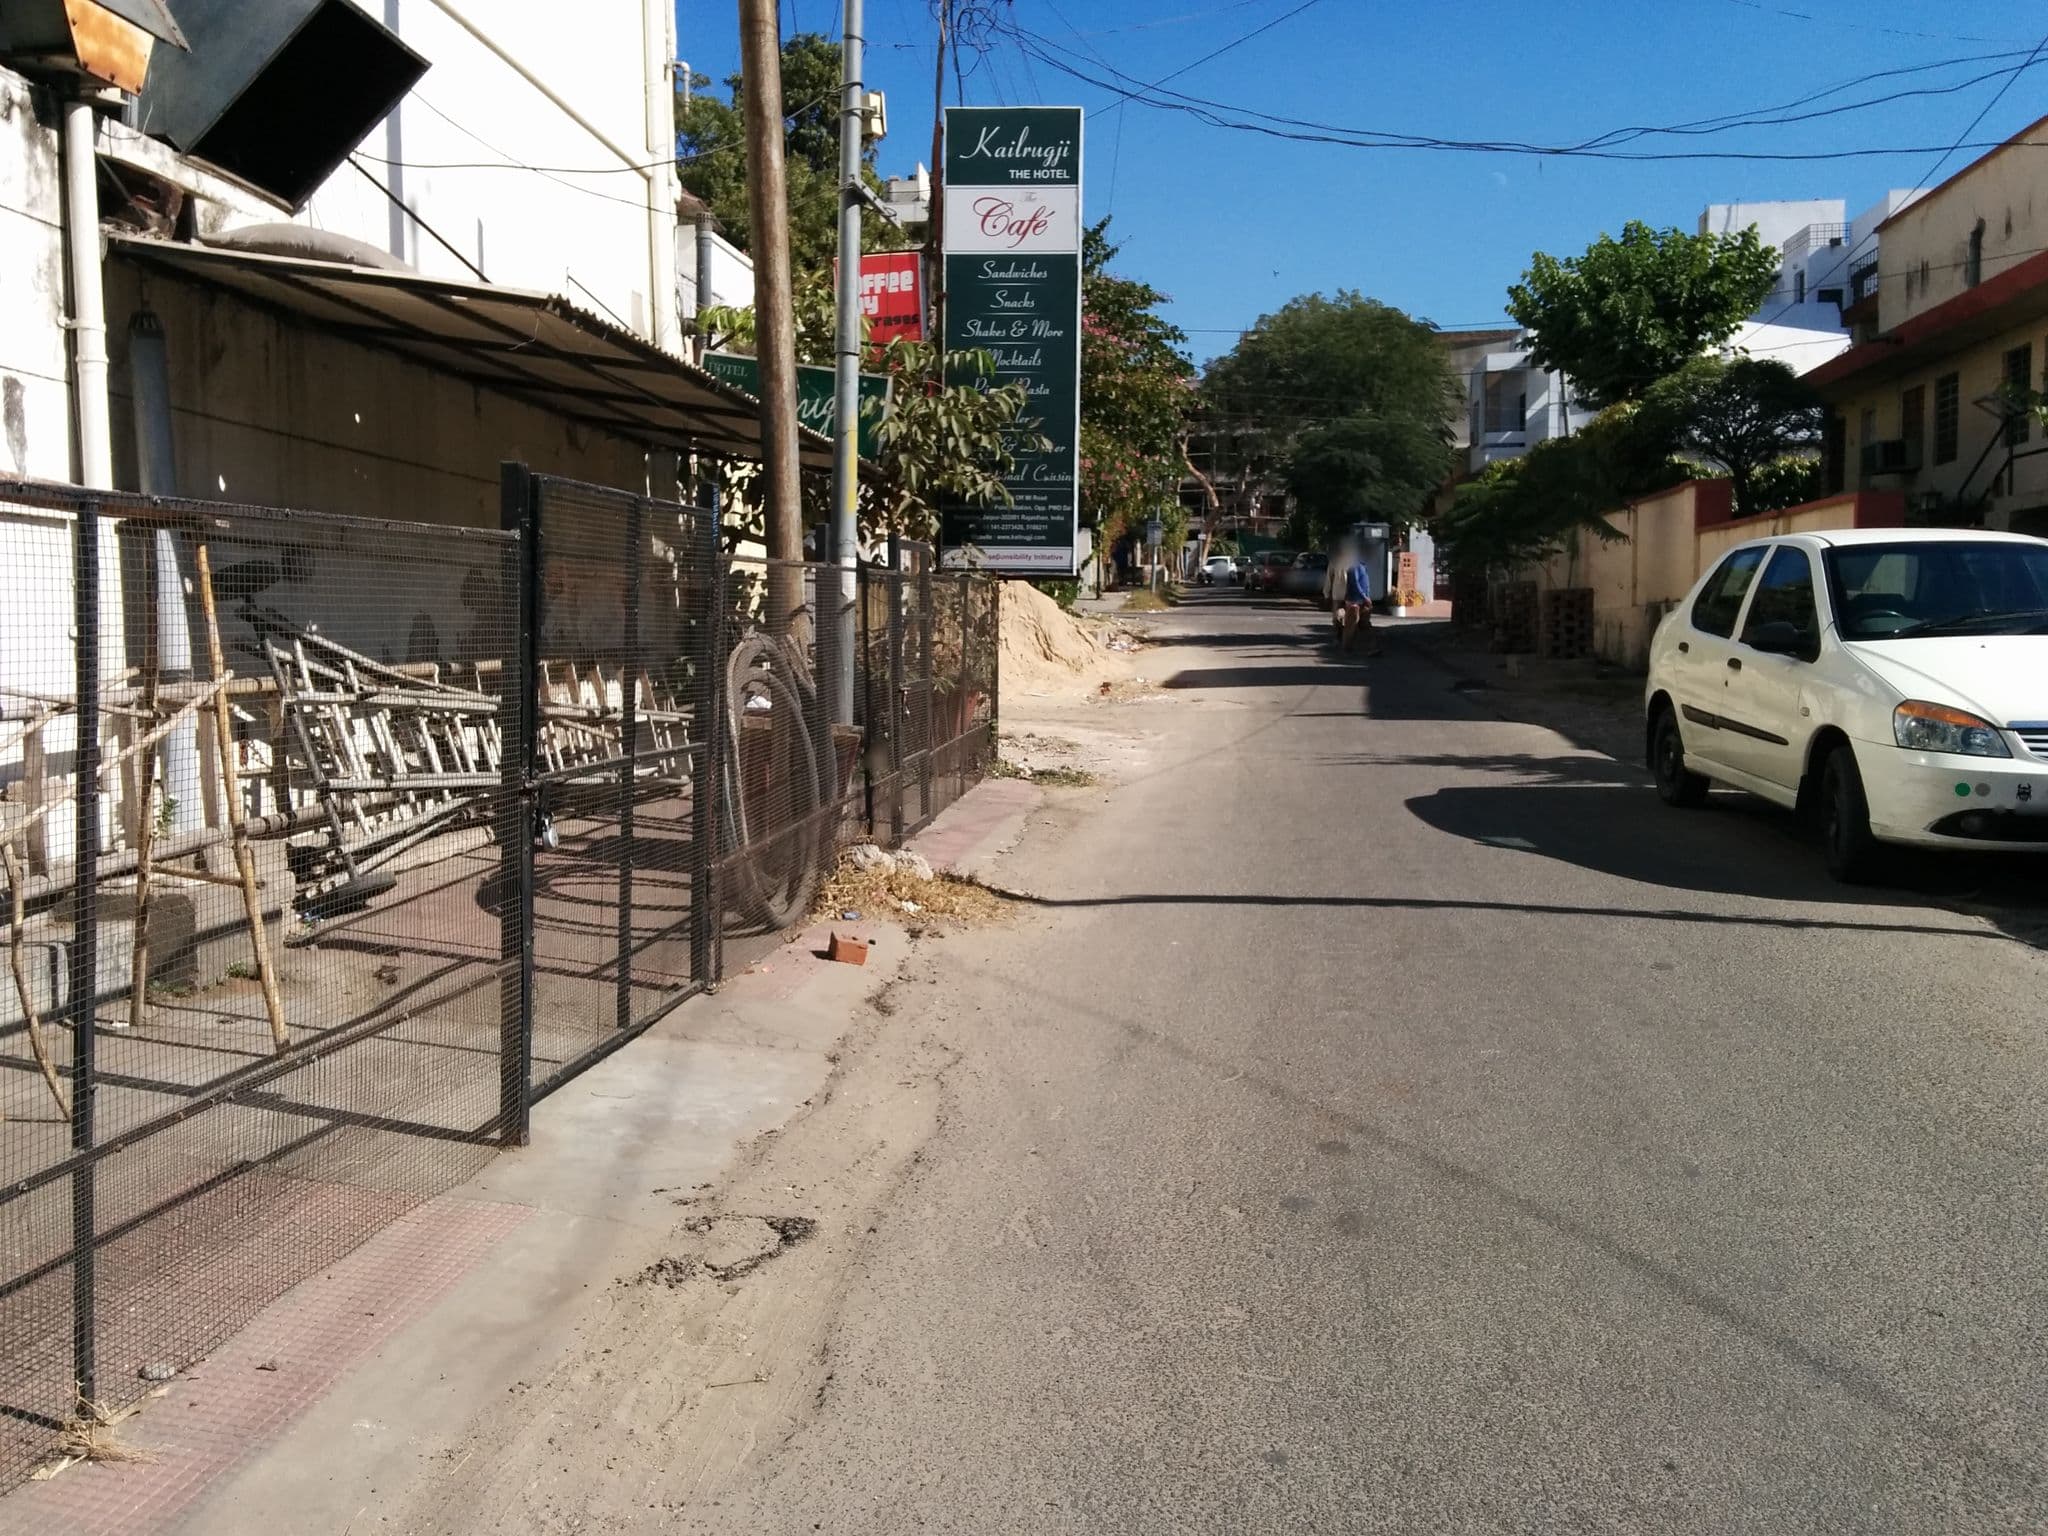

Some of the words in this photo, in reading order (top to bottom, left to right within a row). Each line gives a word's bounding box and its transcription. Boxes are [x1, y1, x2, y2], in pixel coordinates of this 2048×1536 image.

[959, 126, 1071, 167] Kailrugji
[1009, 169, 1030, 179] THE
[1034, 169, 1070, 179] HOTEL
[973, 196, 1055, 248] Café
[978, 260, 1048, 279] Sandwiches
[990, 289, 1036, 308] Snacks
[961, 319, 1007, 337] Shakes
[1010, 320, 1028, 337] &
[1032, 319, 1064, 338] More
[984, 348, 1042, 367] Mocktails
[986, 553, 1032, 562] esponsibility
